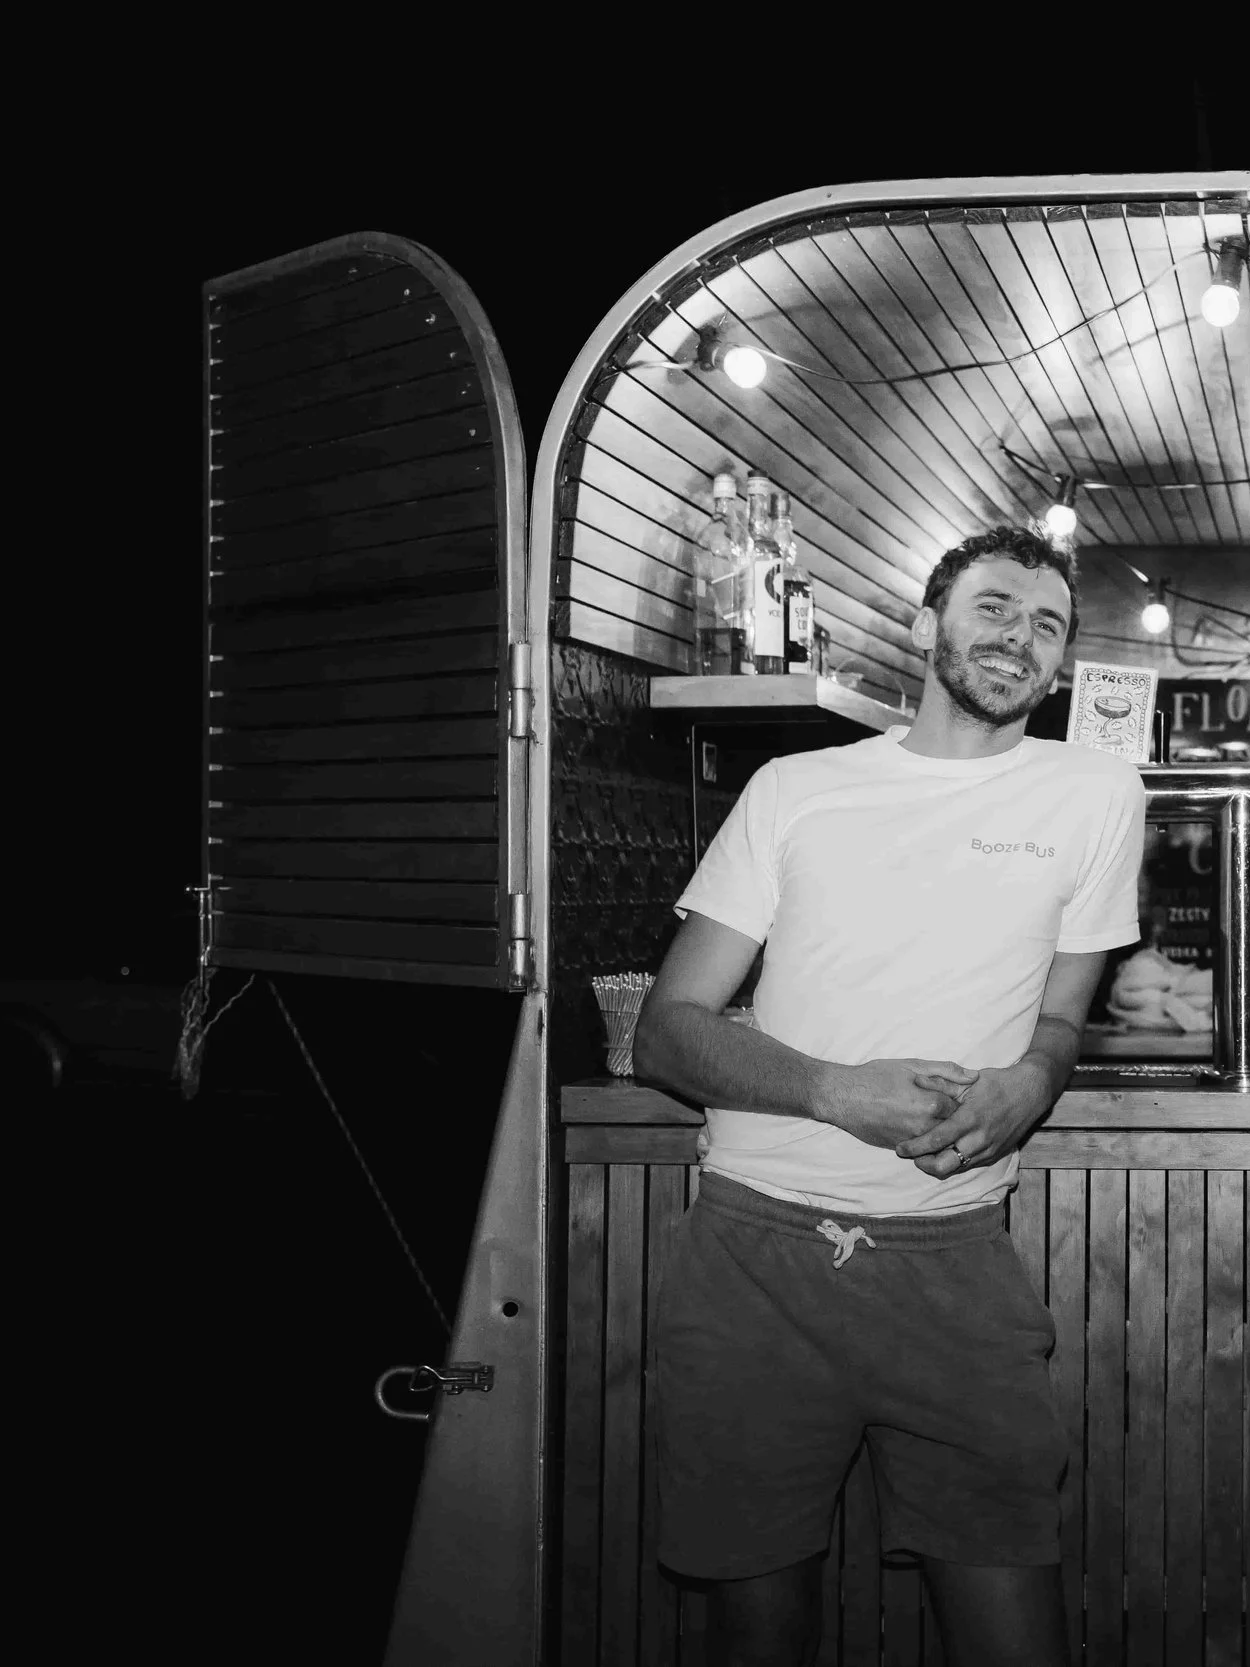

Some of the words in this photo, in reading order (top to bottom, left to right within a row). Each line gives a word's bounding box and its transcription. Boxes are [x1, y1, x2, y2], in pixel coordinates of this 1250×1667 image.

[1087, 672, 1146, 687] ESPRESSO
[971, 838, 1021, 854] BOOZE
[1025, 842, 1056, 858] BUS
